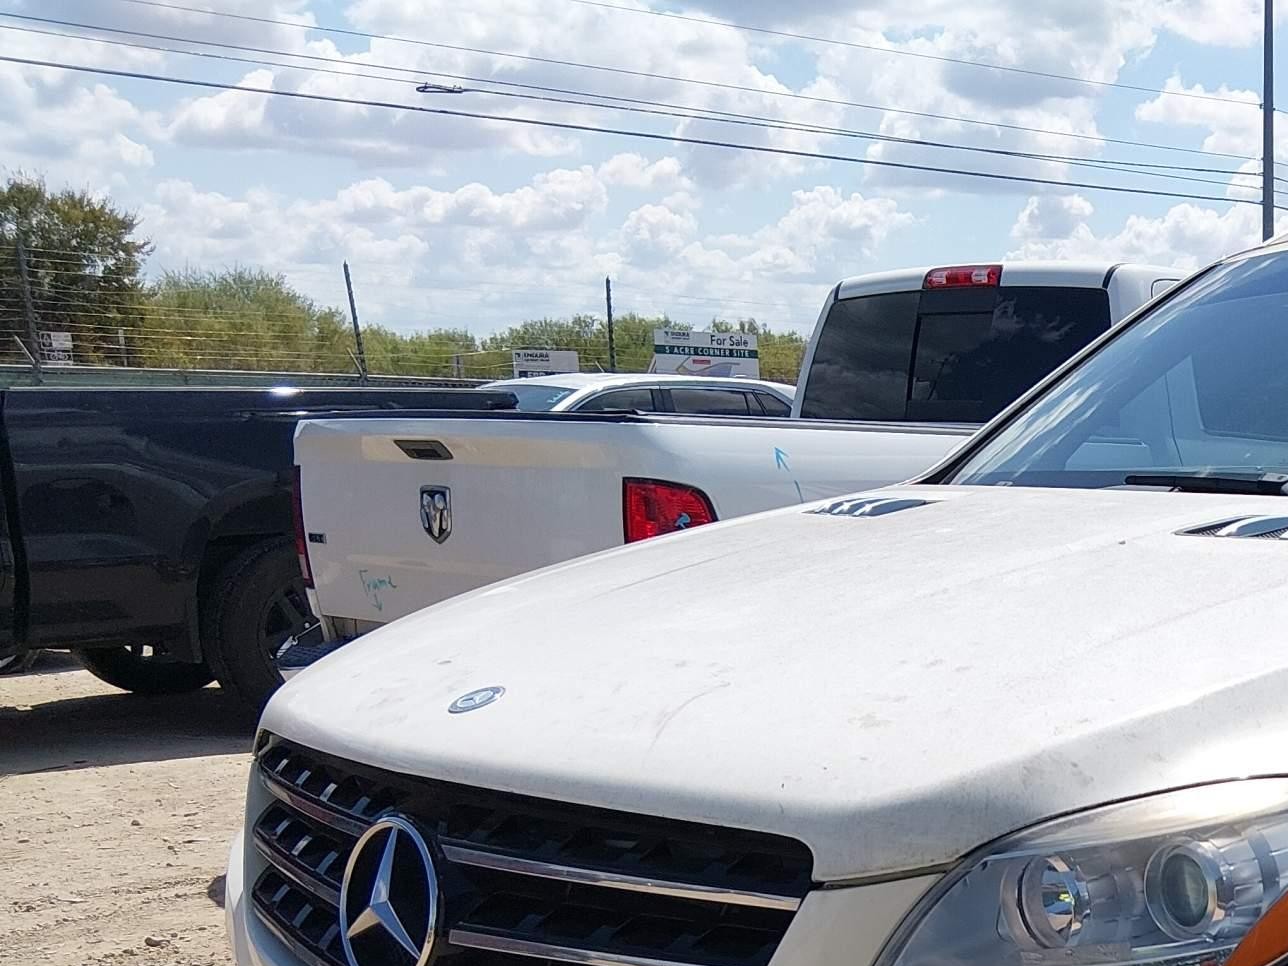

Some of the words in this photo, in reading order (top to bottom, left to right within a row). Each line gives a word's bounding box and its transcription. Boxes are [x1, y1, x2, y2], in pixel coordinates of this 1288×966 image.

[710, 335, 726, 346] For
[729, 335, 748, 347] Sale
[673, 346, 695, 355] ACRE
[698, 347, 728, 357] CORNER
[732, 349, 750, 357] SITE
